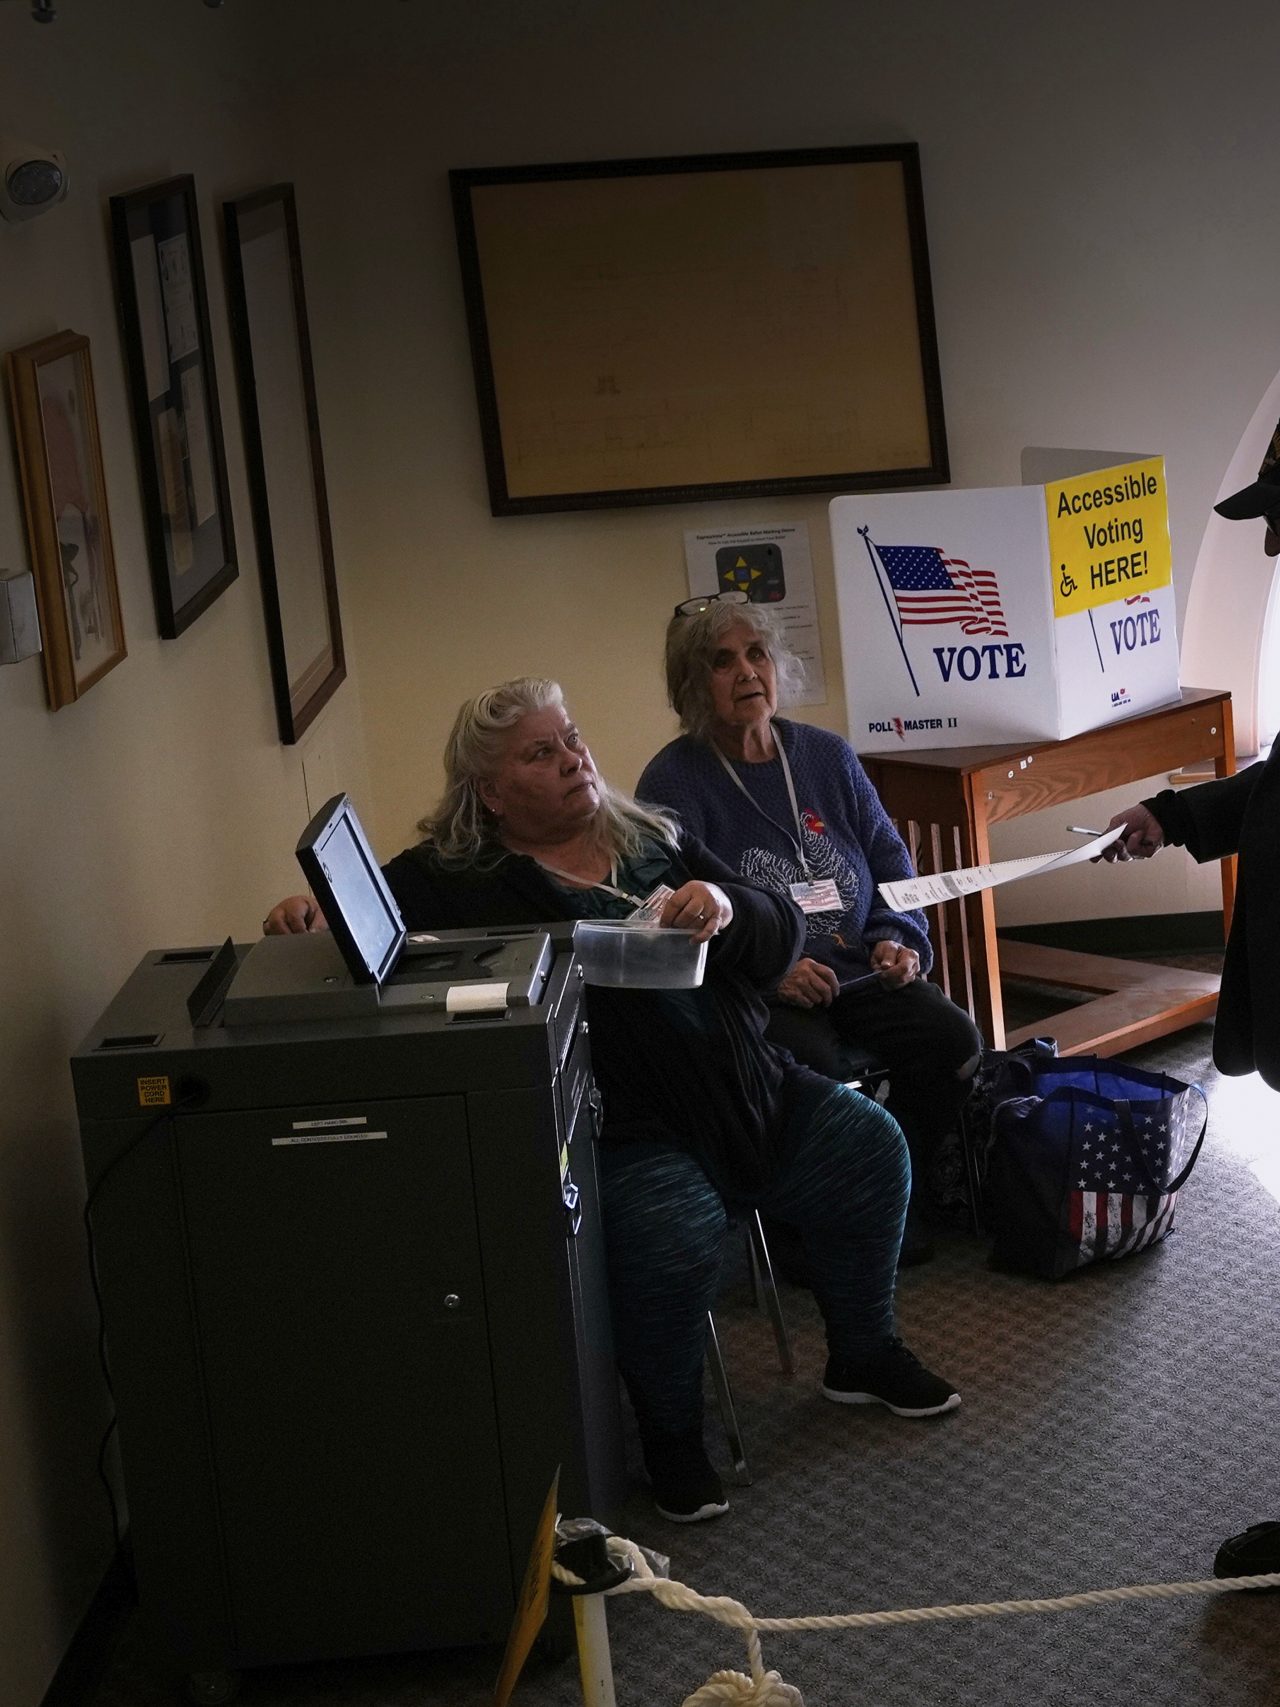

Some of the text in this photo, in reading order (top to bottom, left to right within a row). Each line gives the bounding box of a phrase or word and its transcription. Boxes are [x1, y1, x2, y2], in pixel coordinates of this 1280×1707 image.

[1058, 472, 1157, 518] Accessible
[1084, 518, 1144, 550] Voting
[1090, 550, 1148, 590] HERE!
[1110, 608, 1161, 655] VOTE
[933, 643, 1027, 682] VOTE
[868, 717, 958, 733] POLL MASTER II
